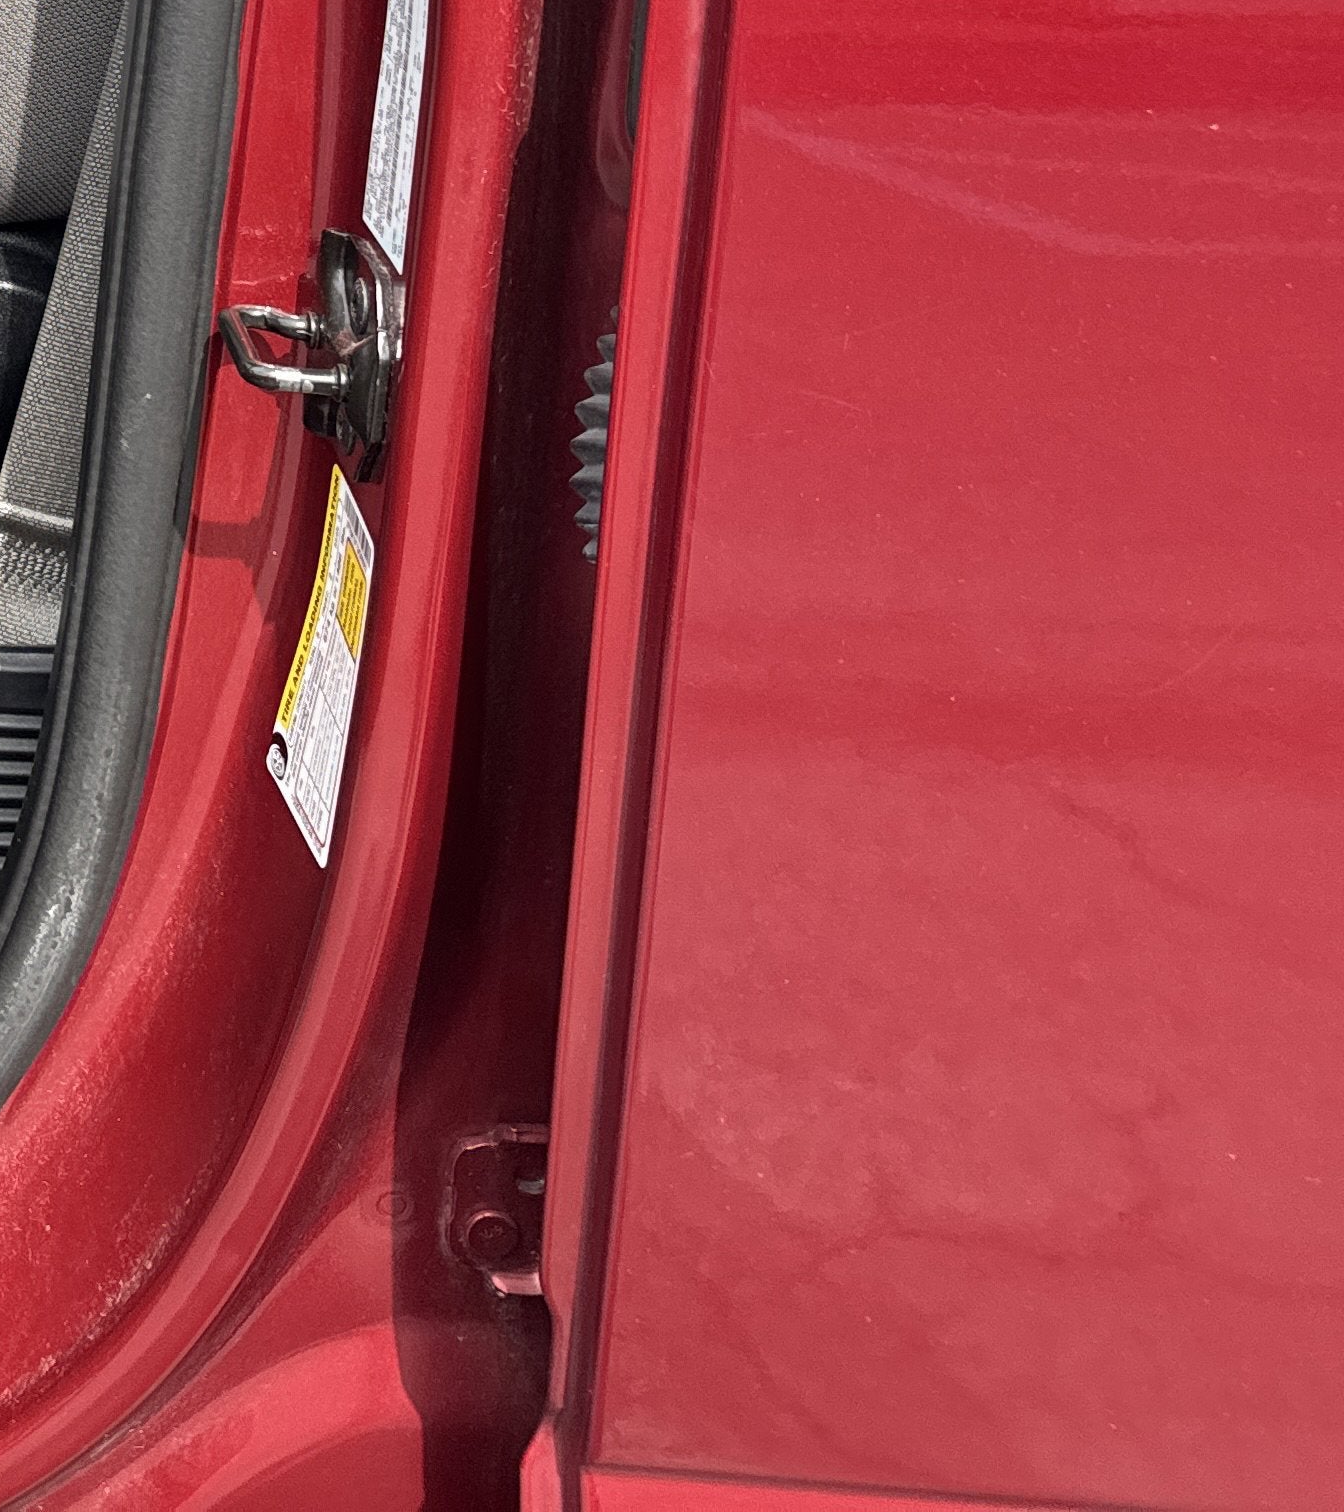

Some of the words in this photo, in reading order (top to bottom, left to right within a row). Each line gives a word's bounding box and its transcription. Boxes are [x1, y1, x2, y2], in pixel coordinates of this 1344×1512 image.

[281, 696, 294, 723] TIRE
[292, 656, 305, 687] AND
[303, 584, 324, 648] LOADING
[319, 474, 340, 581] INFORMATION
